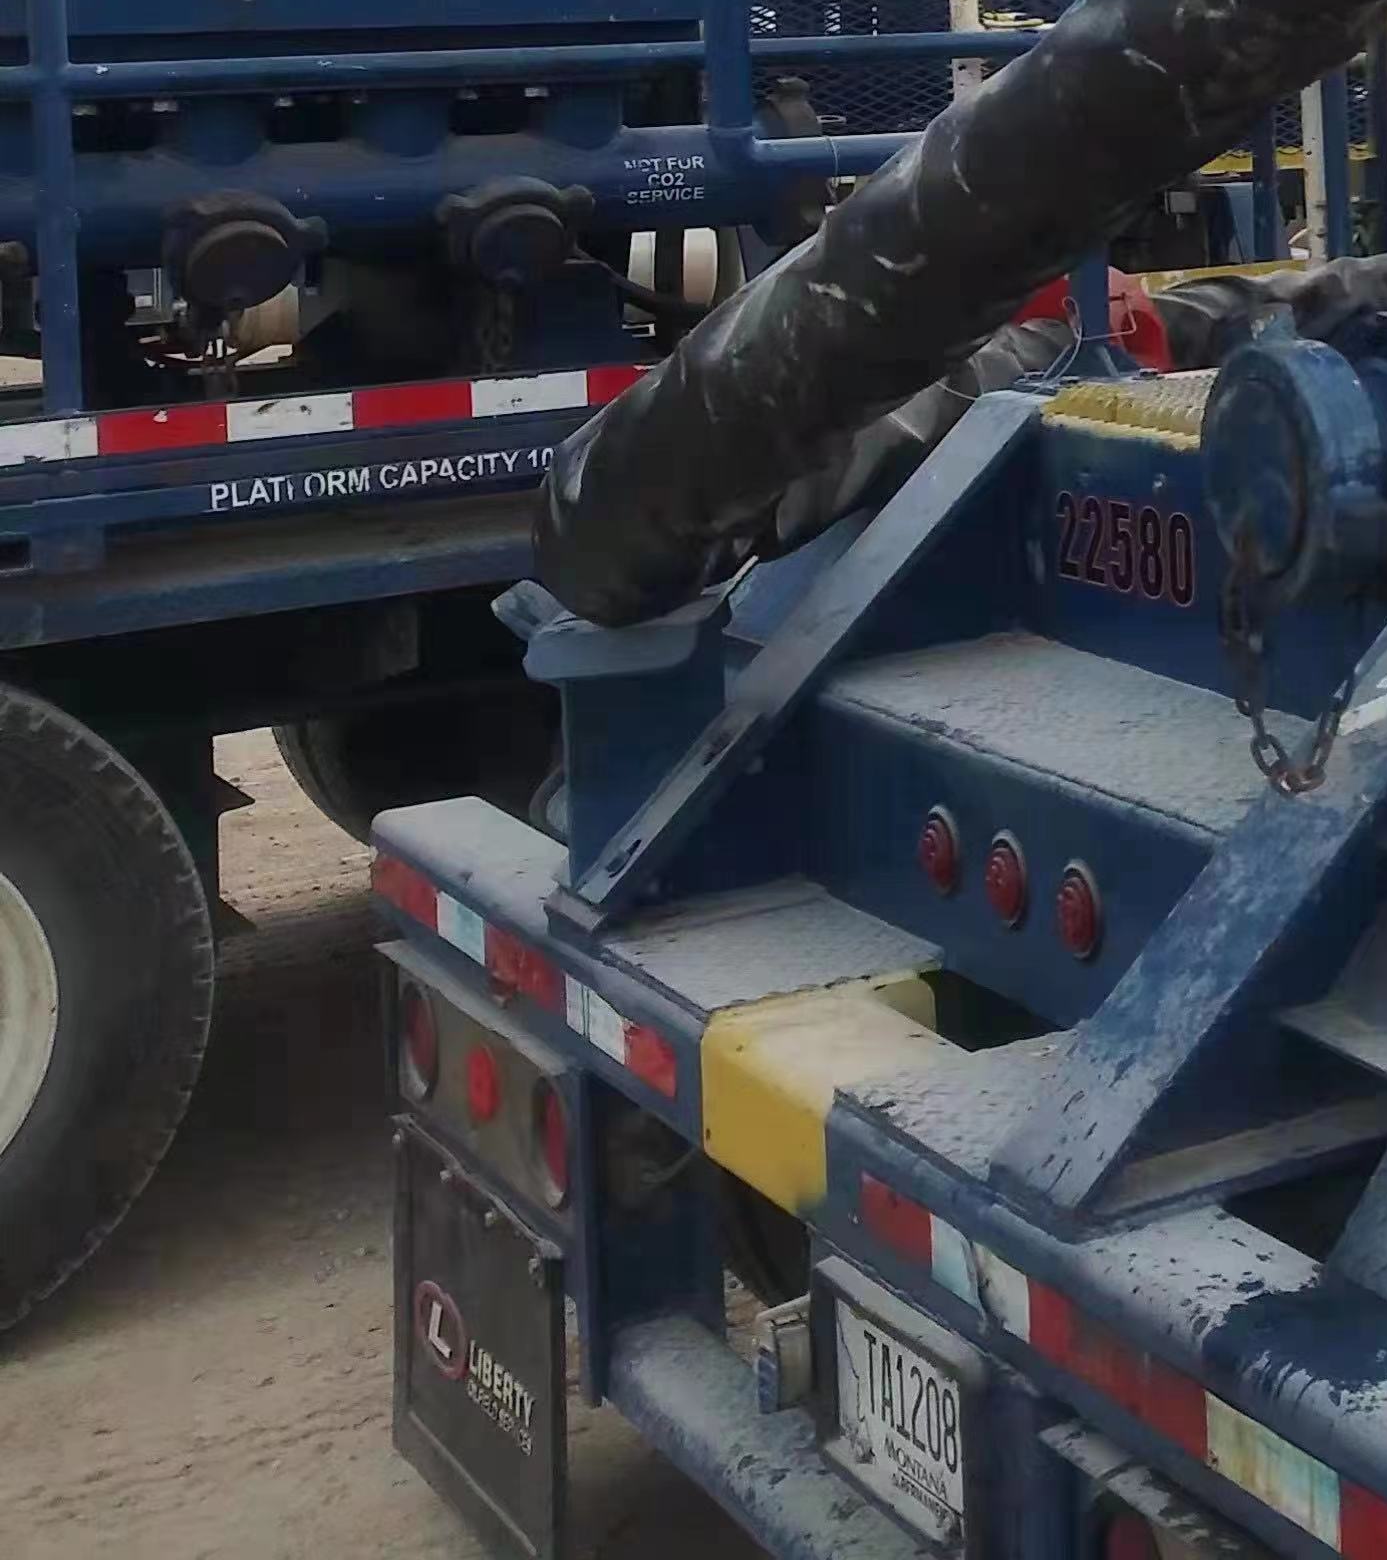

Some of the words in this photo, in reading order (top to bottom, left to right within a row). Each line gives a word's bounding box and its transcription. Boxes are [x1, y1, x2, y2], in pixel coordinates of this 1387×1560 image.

[627, 186, 704, 204] SERVICE
[648, 173, 685, 186] CO2
[210, 467, 370, 512] PLATORM
[379, 450, 521, 490] CAPACITY
[1055, 490, 1195, 608] 22580
[468, 1339, 536, 1428] LIBERTY
[864, 1329, 959, 1474] TA1208
[884, 1437, 949, 1501] MONTANA
